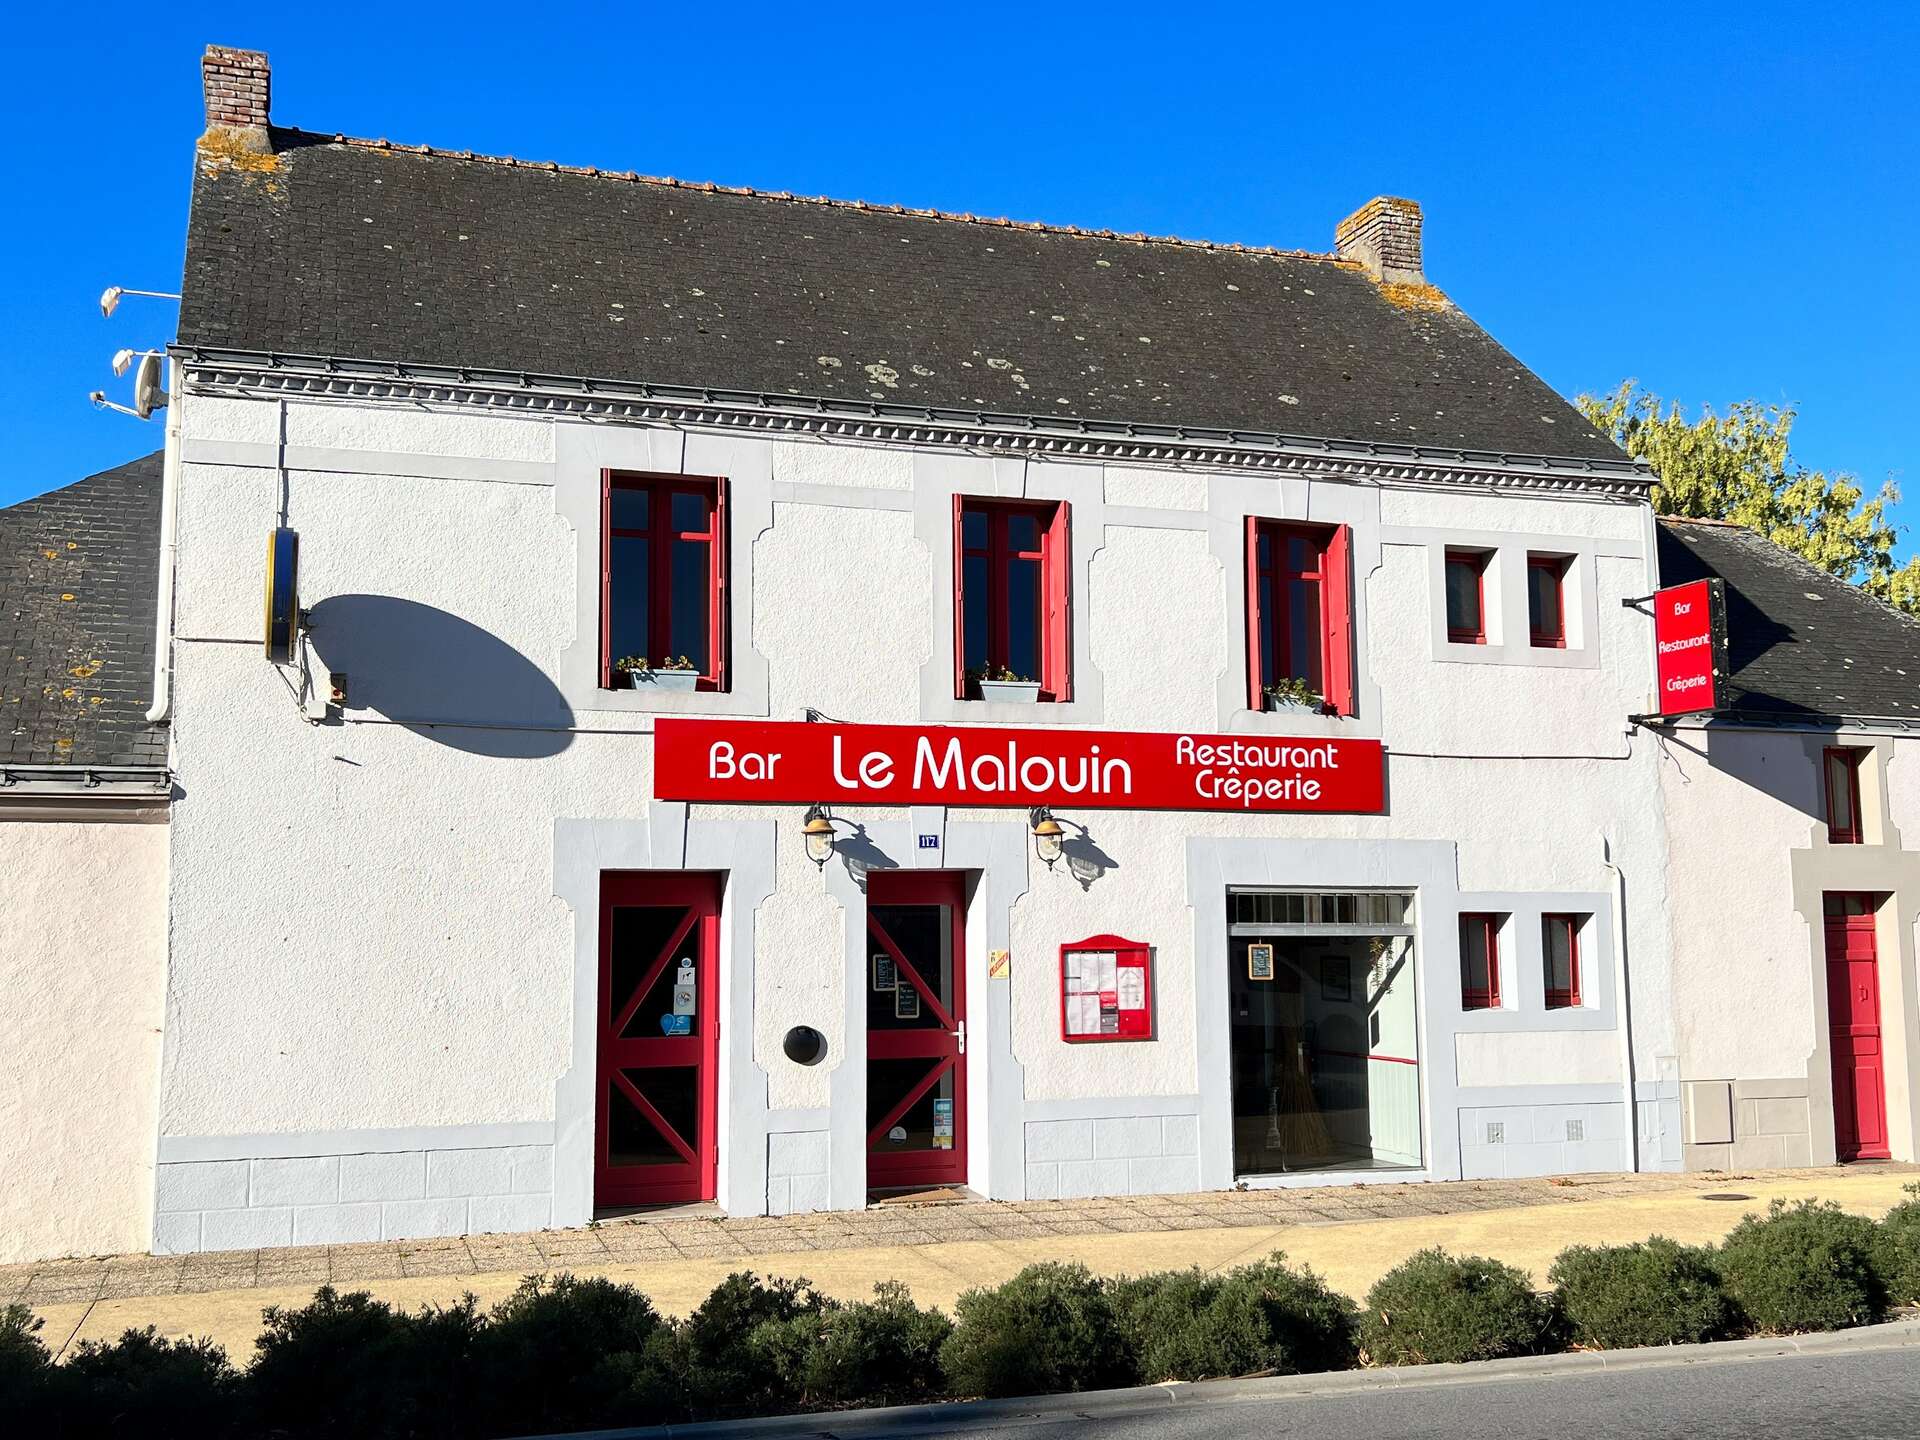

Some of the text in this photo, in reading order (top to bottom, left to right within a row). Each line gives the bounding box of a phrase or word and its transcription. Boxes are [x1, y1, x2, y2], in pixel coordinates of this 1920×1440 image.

[1674, 602, 1692, 616] Bar
[1658, 632, 1711, 655] Restaurant
[1666, 674, 1707, 693] Crêperie
[708, 740, 782, 781] Bar
[832, 735, 1132, 794] Le Malouin
[1176, 735, 1340, 770] Restaurant
[1194, 766, 1323, 808] Crêperie
[921, 836, 936, 847] 117
